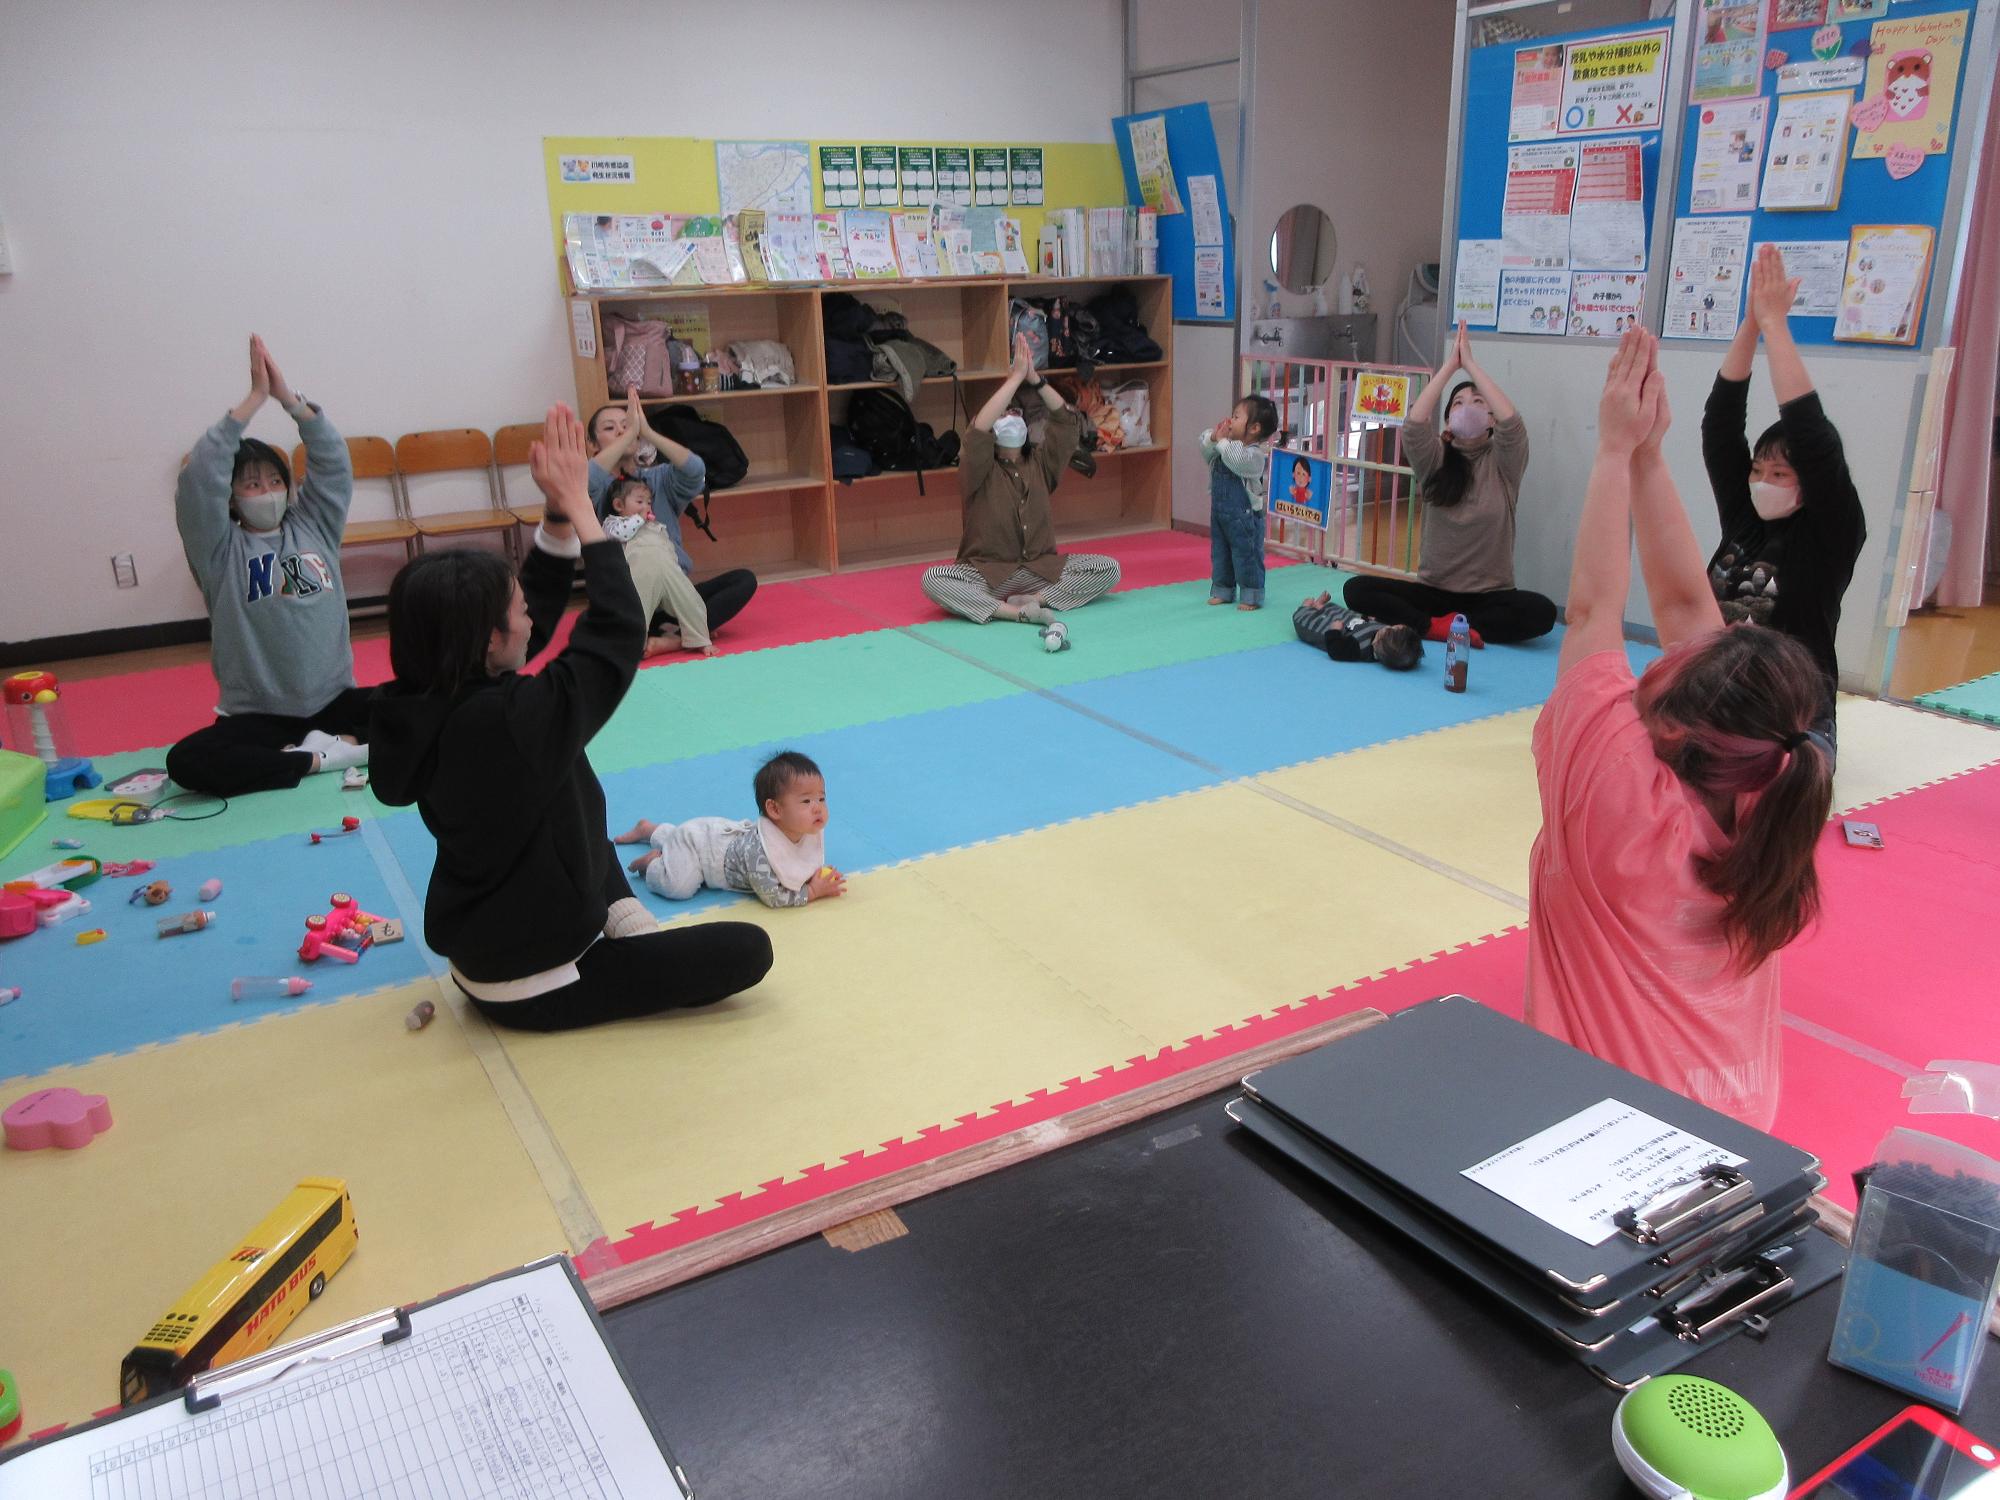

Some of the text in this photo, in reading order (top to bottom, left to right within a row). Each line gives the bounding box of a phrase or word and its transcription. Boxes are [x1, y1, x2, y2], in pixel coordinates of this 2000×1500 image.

[1875, 23, 1909, 38] Happy
[1571, 42, 1661, 65] 授乳や水分補給以外の
[1592, 292, 1622, 300] お子様から
[1276, 502, 1320, 522] はいらないでね
[245, 1286, 287, 1337] HATO
[289, 1252, 317, 1293] BUS
[1926, 1366, 1955, 1381] CLIP
